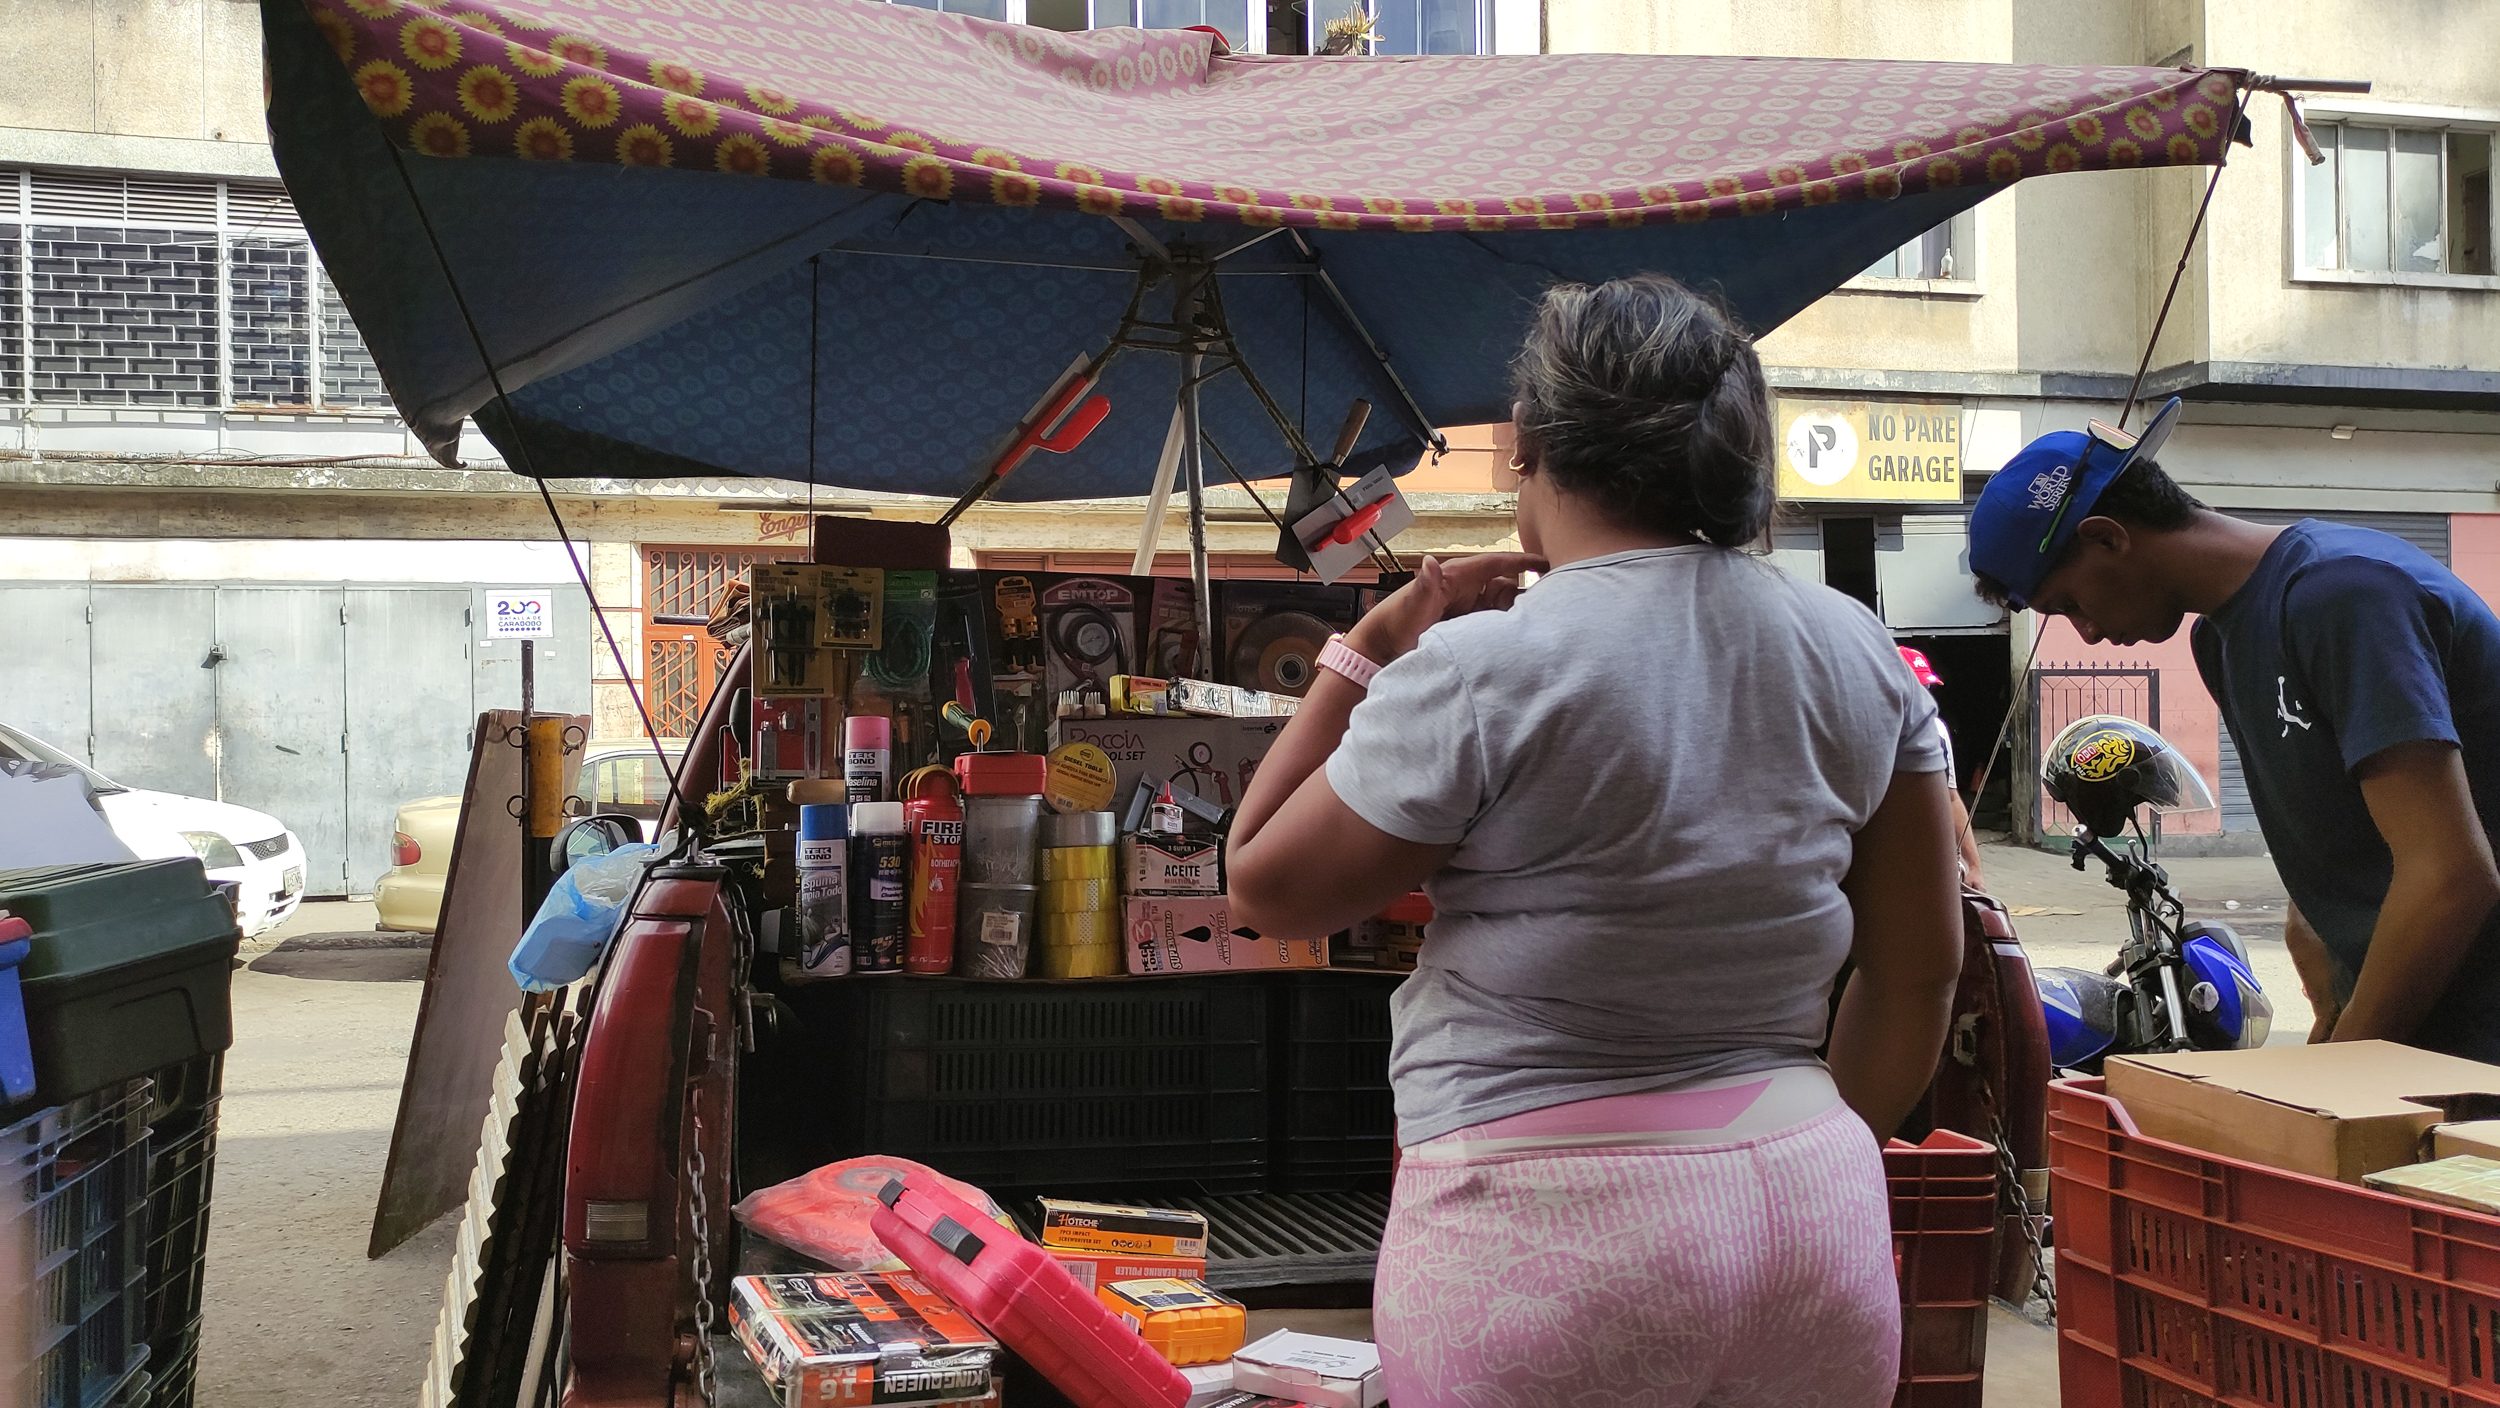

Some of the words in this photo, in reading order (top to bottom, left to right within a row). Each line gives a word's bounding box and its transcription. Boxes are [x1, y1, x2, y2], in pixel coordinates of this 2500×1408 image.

[1868, 413, 1896, 442] NO
[1905, 415, 1956, 443] PARE
[1868, 454, 1955, 483] GARAGE
[2027, 465, 2068, 509] WORLD
[1057, 589, 1119, 600] EMTOP
[497, 600, 541, 615] 200
[1125, 751, 1146, 761] SET
[1064, 755, 1083, 767] DIESEL
[1085, 762, 1103, 774] TOOLS
[922, 821, 961, 834] FIRE
[879, 856, 901, 868] 530
[1164, 865, 1201, 877] ACEITE
[821, 884, 843, 898] Todo
[1164, 910, 1174, 938] DURO
[1166, 938, 1183, 970] SUPER
[1220, 939, 1231, 965] ABRE
[1058, 1213, 1100, 1228] HOTECHE
[1115, 1266, 1142, 1276] PULLER
[1143, 1267, 1177, 1277] BEARING
[820, 1377, 857, 1400] 16
[884, 1369, 983, 1394] KINGQUEEN
